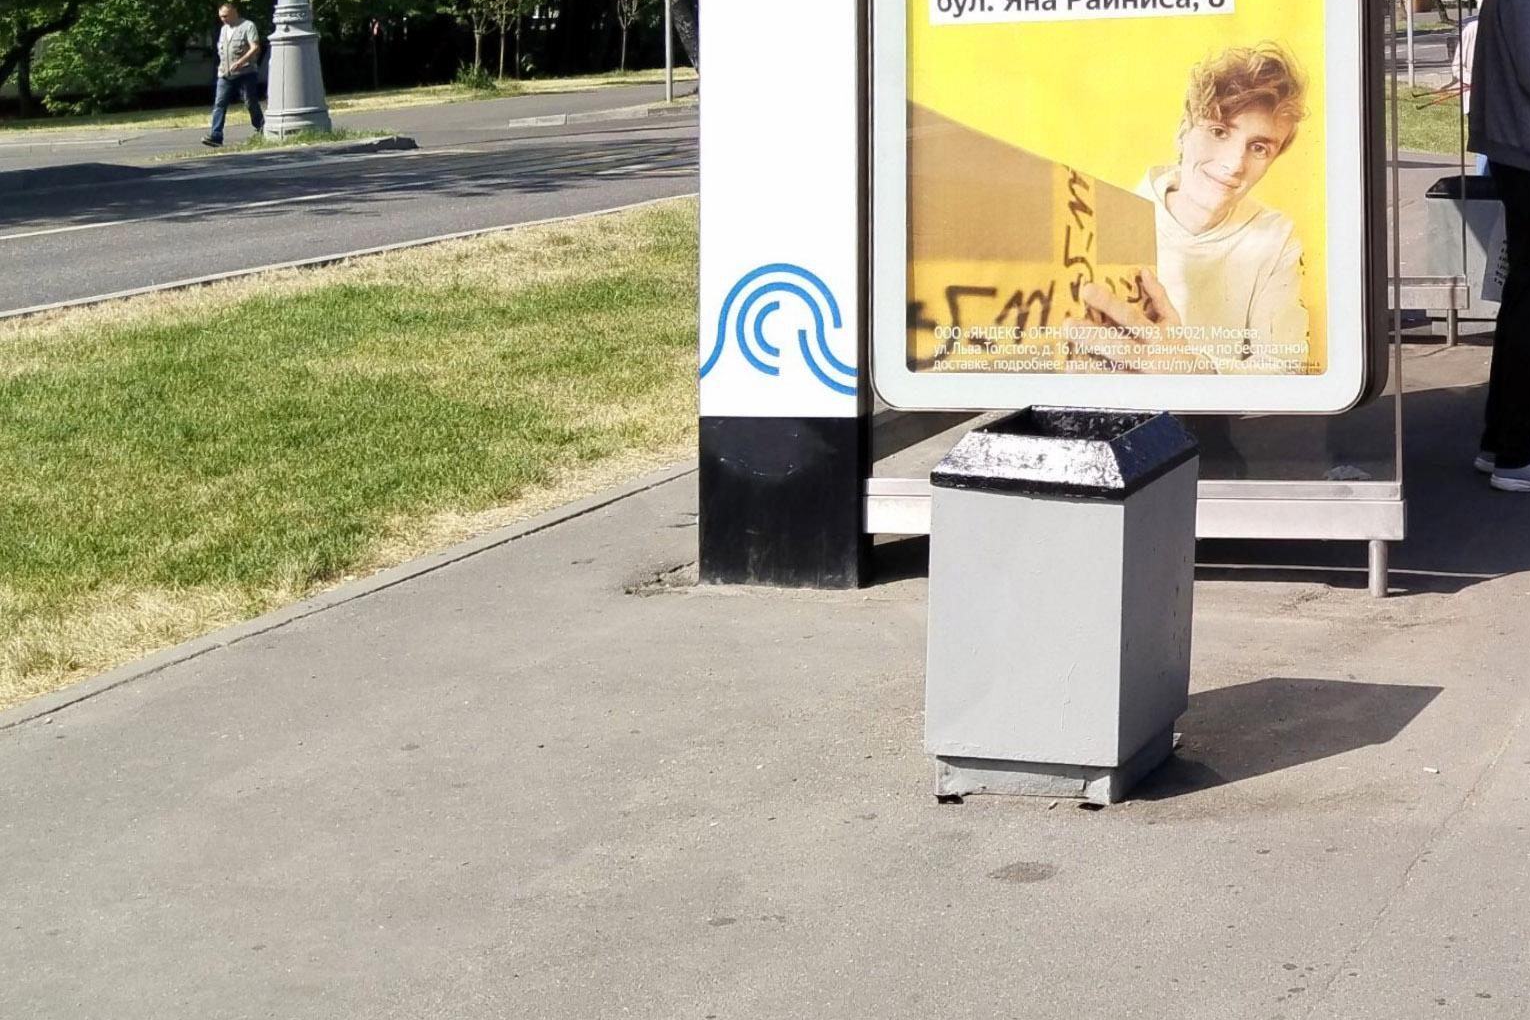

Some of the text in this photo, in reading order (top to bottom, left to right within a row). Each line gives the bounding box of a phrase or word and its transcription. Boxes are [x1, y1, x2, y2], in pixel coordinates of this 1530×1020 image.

[934, 326, 962, 340] ООО
[1030, 326, 1062, 340] ОГРН
[1211, 326, 1261, 341] Москва,
[934, 342, 1309, 357] ул. Льва Толстого, д. 16. Имеются ограничения по бесплатной
[993, 357, 1064, 372] подробнее:
